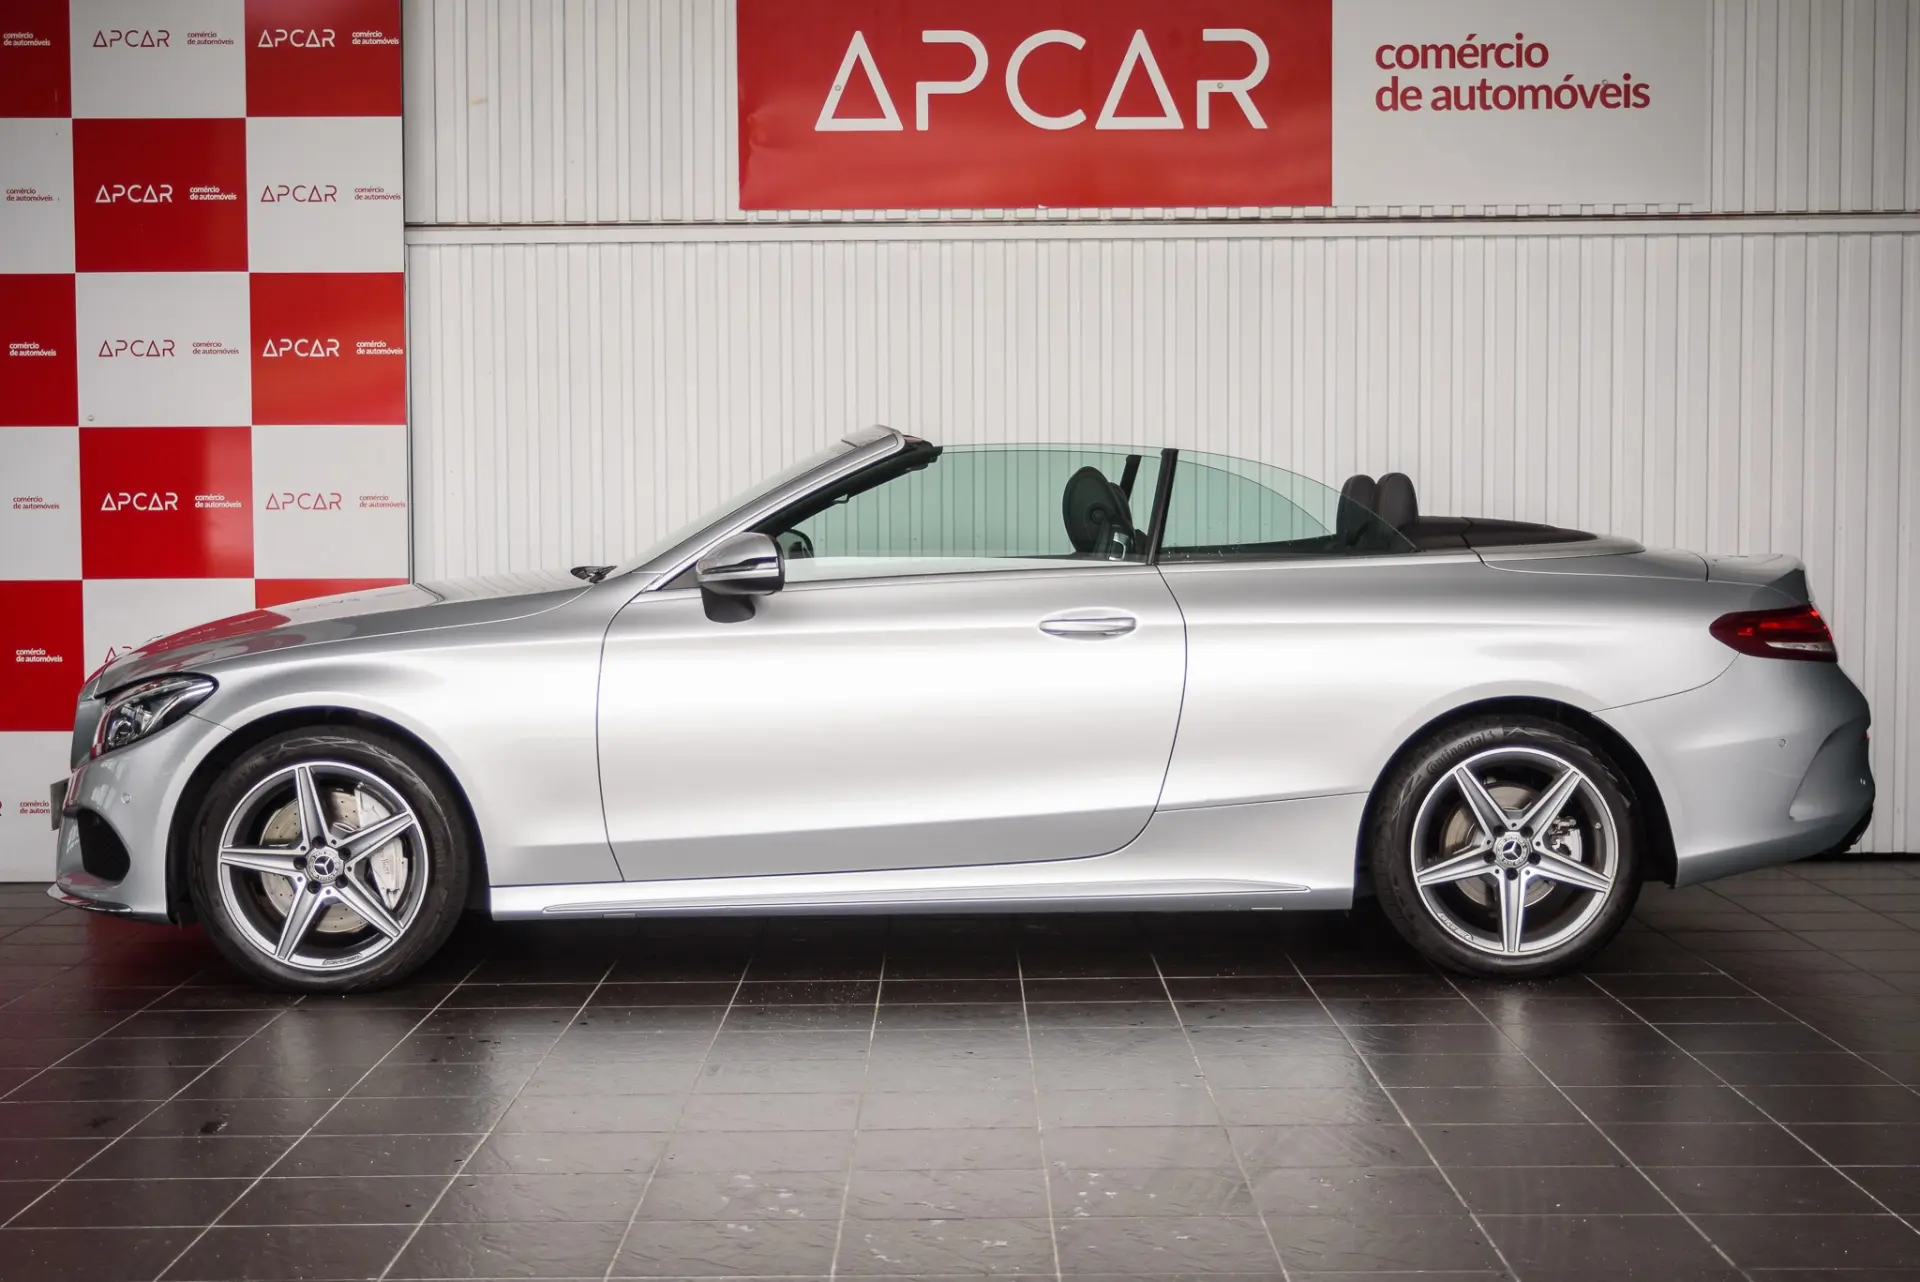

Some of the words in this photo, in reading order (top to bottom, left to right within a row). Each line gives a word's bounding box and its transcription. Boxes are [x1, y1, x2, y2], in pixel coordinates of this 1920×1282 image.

[3, 32, 33, 40] comércio
[93, 30, 169, 47] APCAR
[187, 31, 217, 39] comércio
[258, 29, 335, 47] APCAR
[352, 31, 382, 39] comércio
[1376, 33, 1548, 70] comércio
[815, 29, 1269, 131] APCAR
[1376, 76, 1423, 111] de
[1430, 72, 1650, 111] automóveis
[6, 187, 36, 195] comércio
[96, 185, 172, 202] APCAR
[190, 186, 220, 194] comércio
[261, 185, 337, 202] APCAR
[354, 186, 384, 194] comércio
[9, 342, 39, 350] comércio
[192, 341, 222, 349] comércio
[263, 339, 339, 357] APCAR
[356, 340, 386, 348] comércio
[99, 340, 174, 357] APCAR
[13, 496, 43, 504] comércio
[101, 493, 178, 510] APCAR
[195, 494, 225, 502] comércio
[266, 493, 341, 510] APCAR
[359, 494, 389, 502] comércio
[16, 648, 46, 656] comércio
